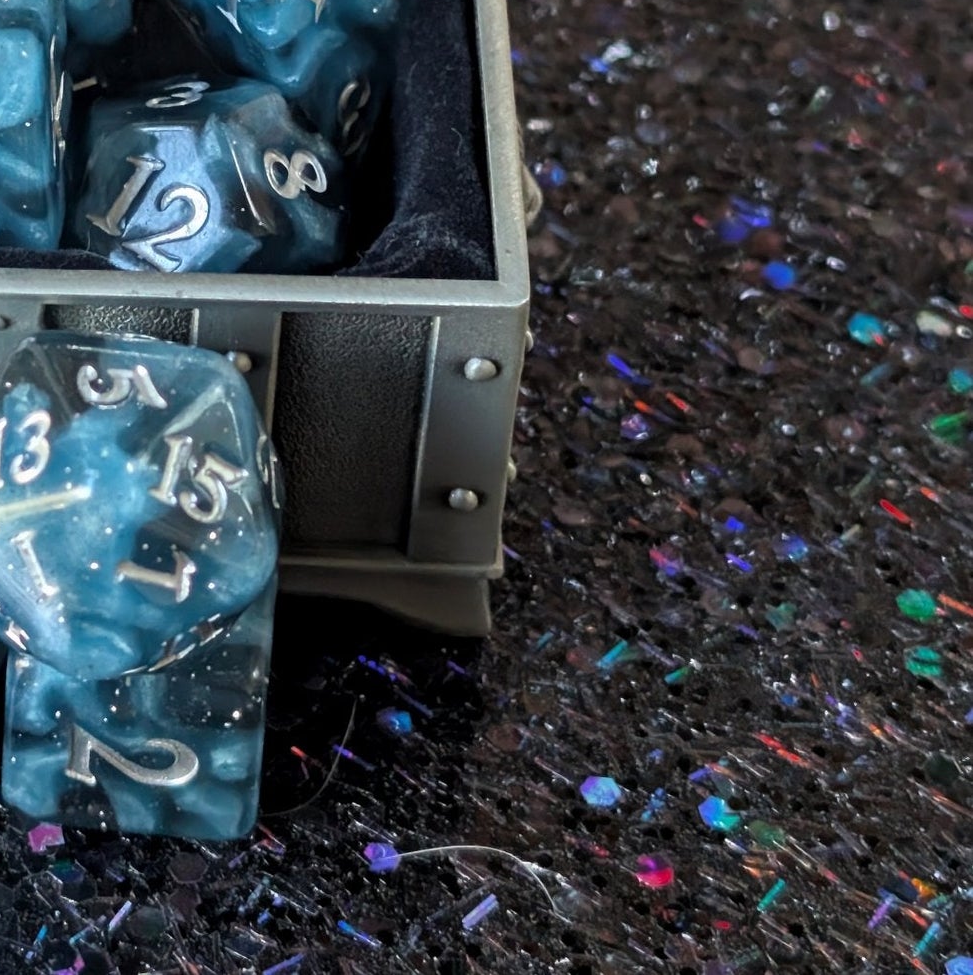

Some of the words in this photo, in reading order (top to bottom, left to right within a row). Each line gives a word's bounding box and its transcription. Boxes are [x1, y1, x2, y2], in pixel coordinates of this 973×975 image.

[264, 148, 327, 199] 8
[85, 154, 210, 272] 12
[77, 364, 167, 409] 5
[149, 434, 248, 523] 15
[65, 723, 199, 786] 2
